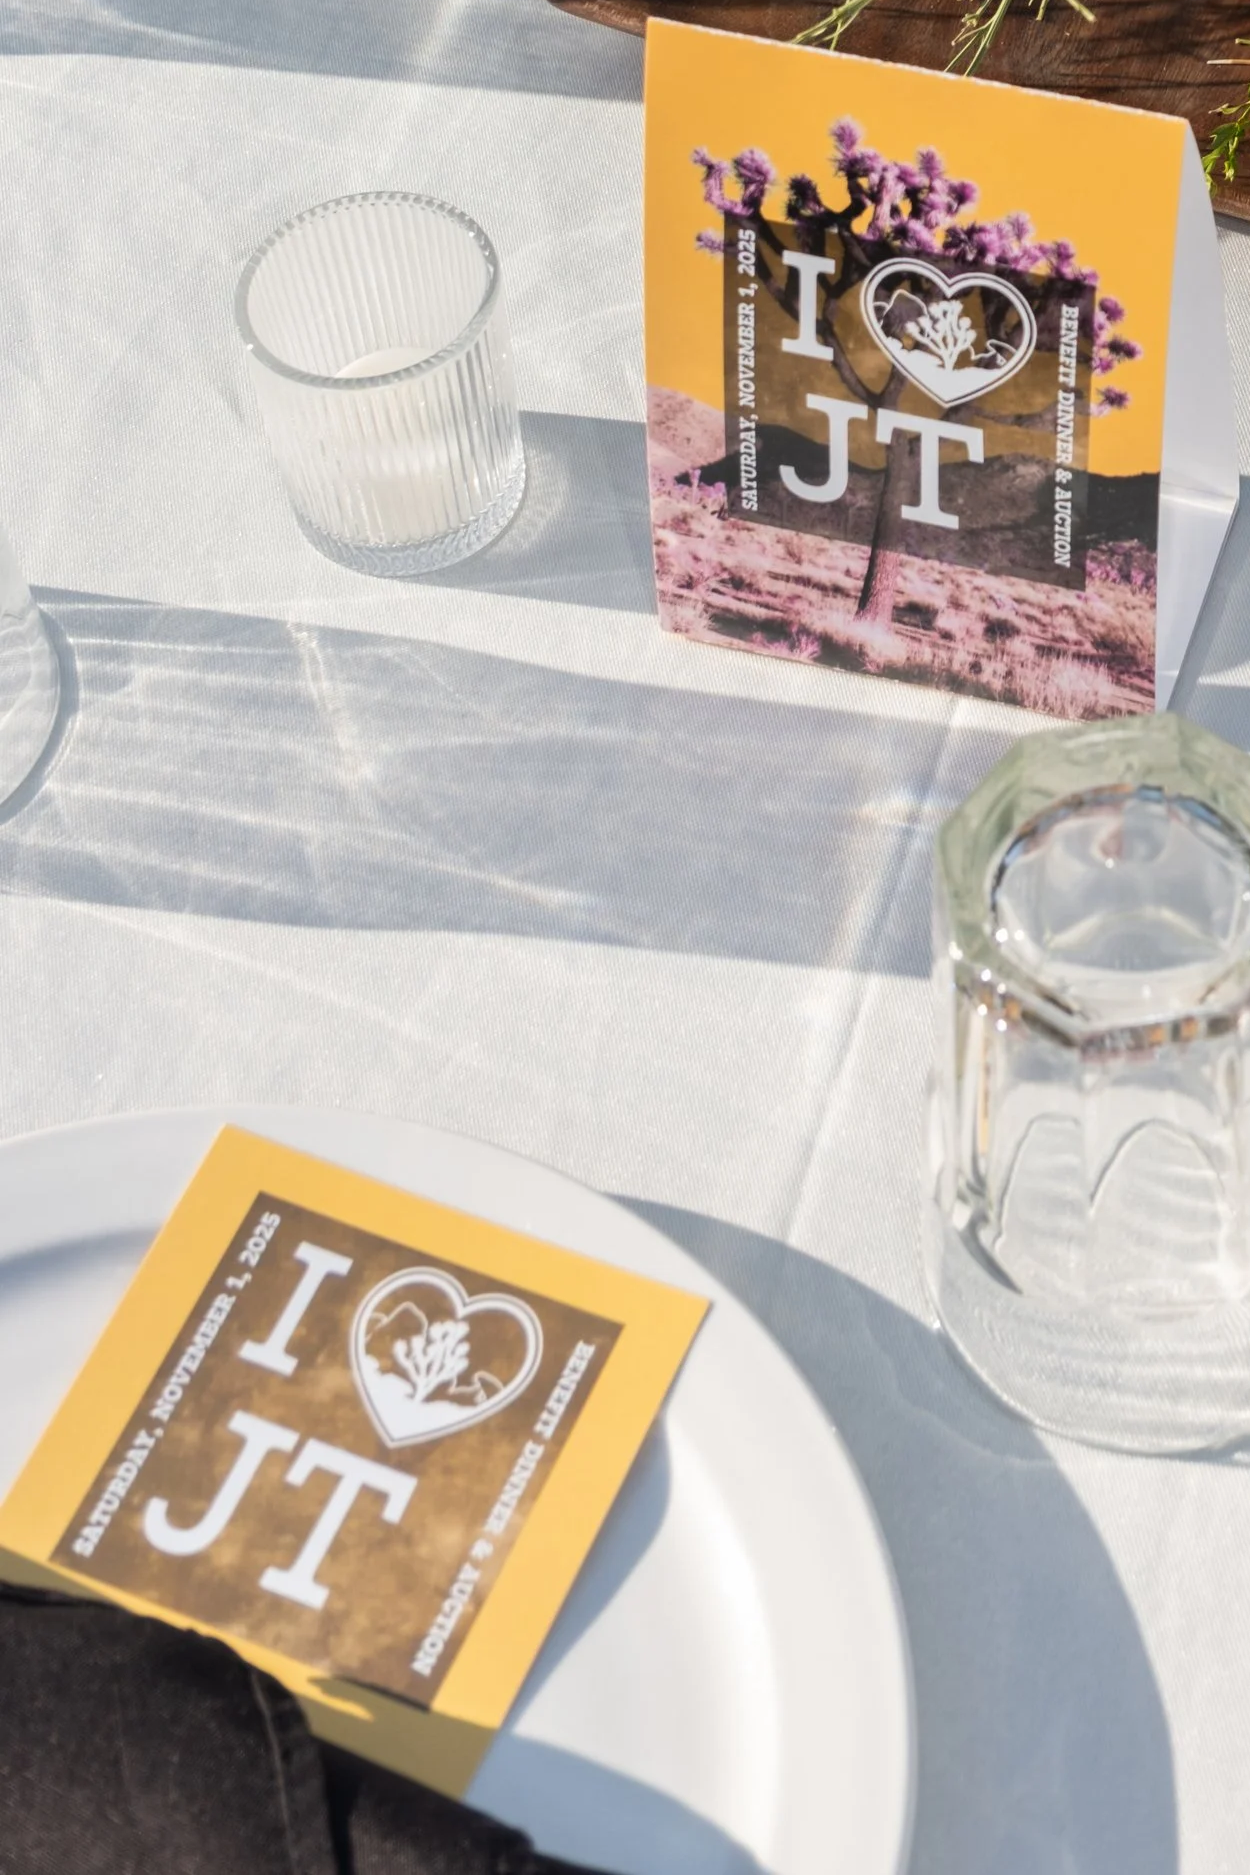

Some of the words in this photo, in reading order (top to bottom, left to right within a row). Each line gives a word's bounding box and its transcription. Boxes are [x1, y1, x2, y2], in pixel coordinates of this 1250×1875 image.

[738, 229, 756, 276] 2025
[738, 283, 758, 297] 1,
[780, 250, 836, 361] I
[1058, 304, 1079, 388] BENEFIT
[737, 302, 756, 408] NOVEMBER
[738, 414, 758, 512] SATURDAY,
[778, 394, 984, 529] JT
[1055, 467, 1073, 485] &
[1056, 389, 1075, 465] DINNER
[1054, 486, 1072, 568] AUCTION
[225, 1272, 252, 1290] 1,
[238, 1211, 281, 1268] 2025
[239, 1240, 353, 1377] I
[150, 1292, 236, 1424] NOVEMBER
[533, 1340, 596, 1440] BENEFIT
[72, 1428, 164, 1559] SATURDAY,
[141, 1408, 418, 1612] JT
[484, 1439, 545, 1535] DINNER
[410, 1562, 481, 1677] AUCTION
